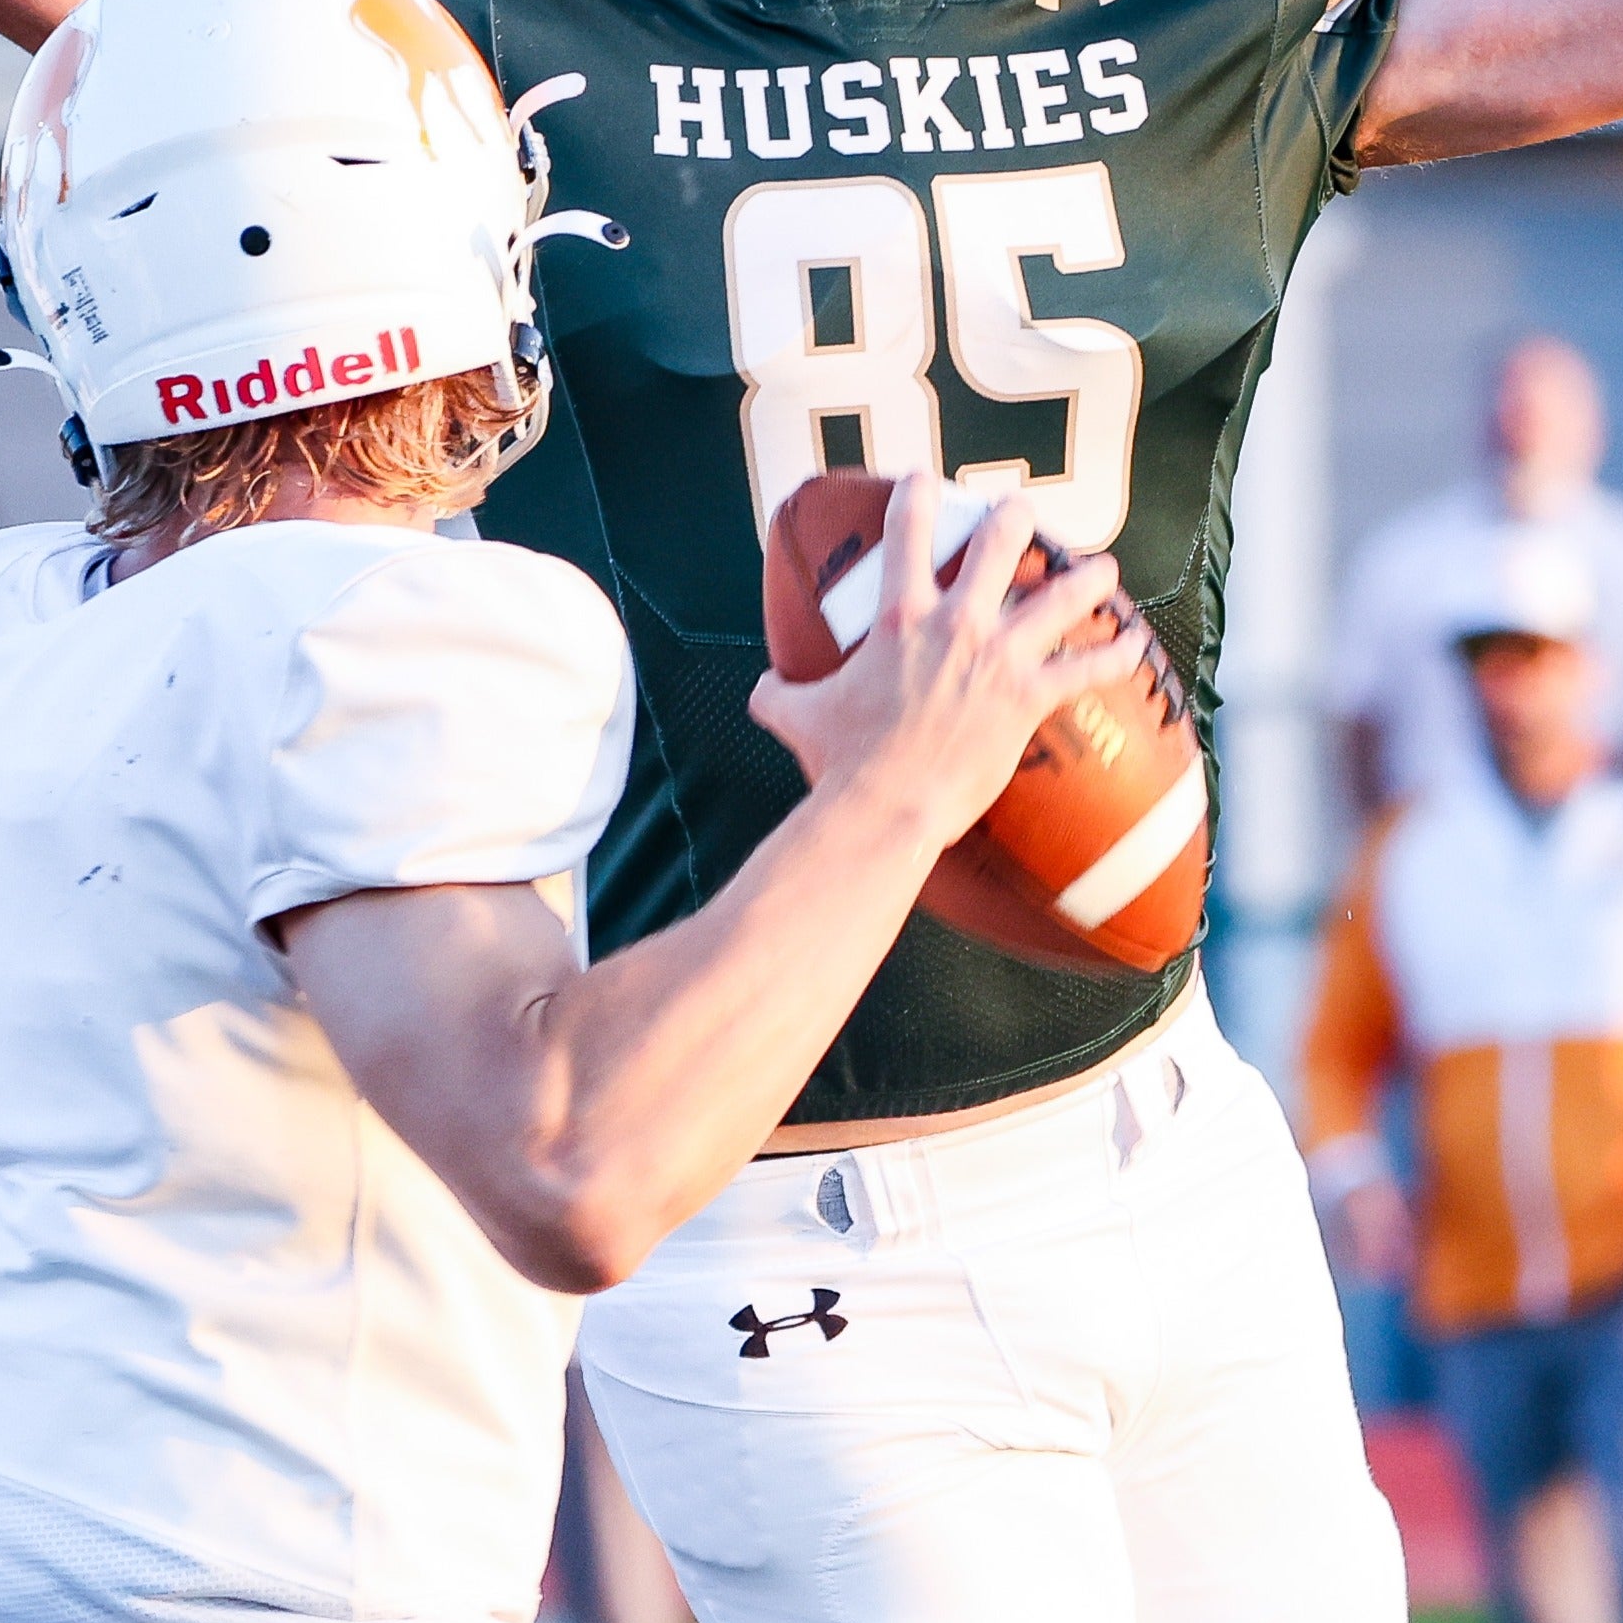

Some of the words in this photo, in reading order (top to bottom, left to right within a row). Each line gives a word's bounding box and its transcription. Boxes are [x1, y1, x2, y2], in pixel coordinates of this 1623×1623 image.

[649, 38, 1149, 160] HUSKIES
[156, 326, 422, 424] Riddell
[722, 160, 1143, 555] 85
